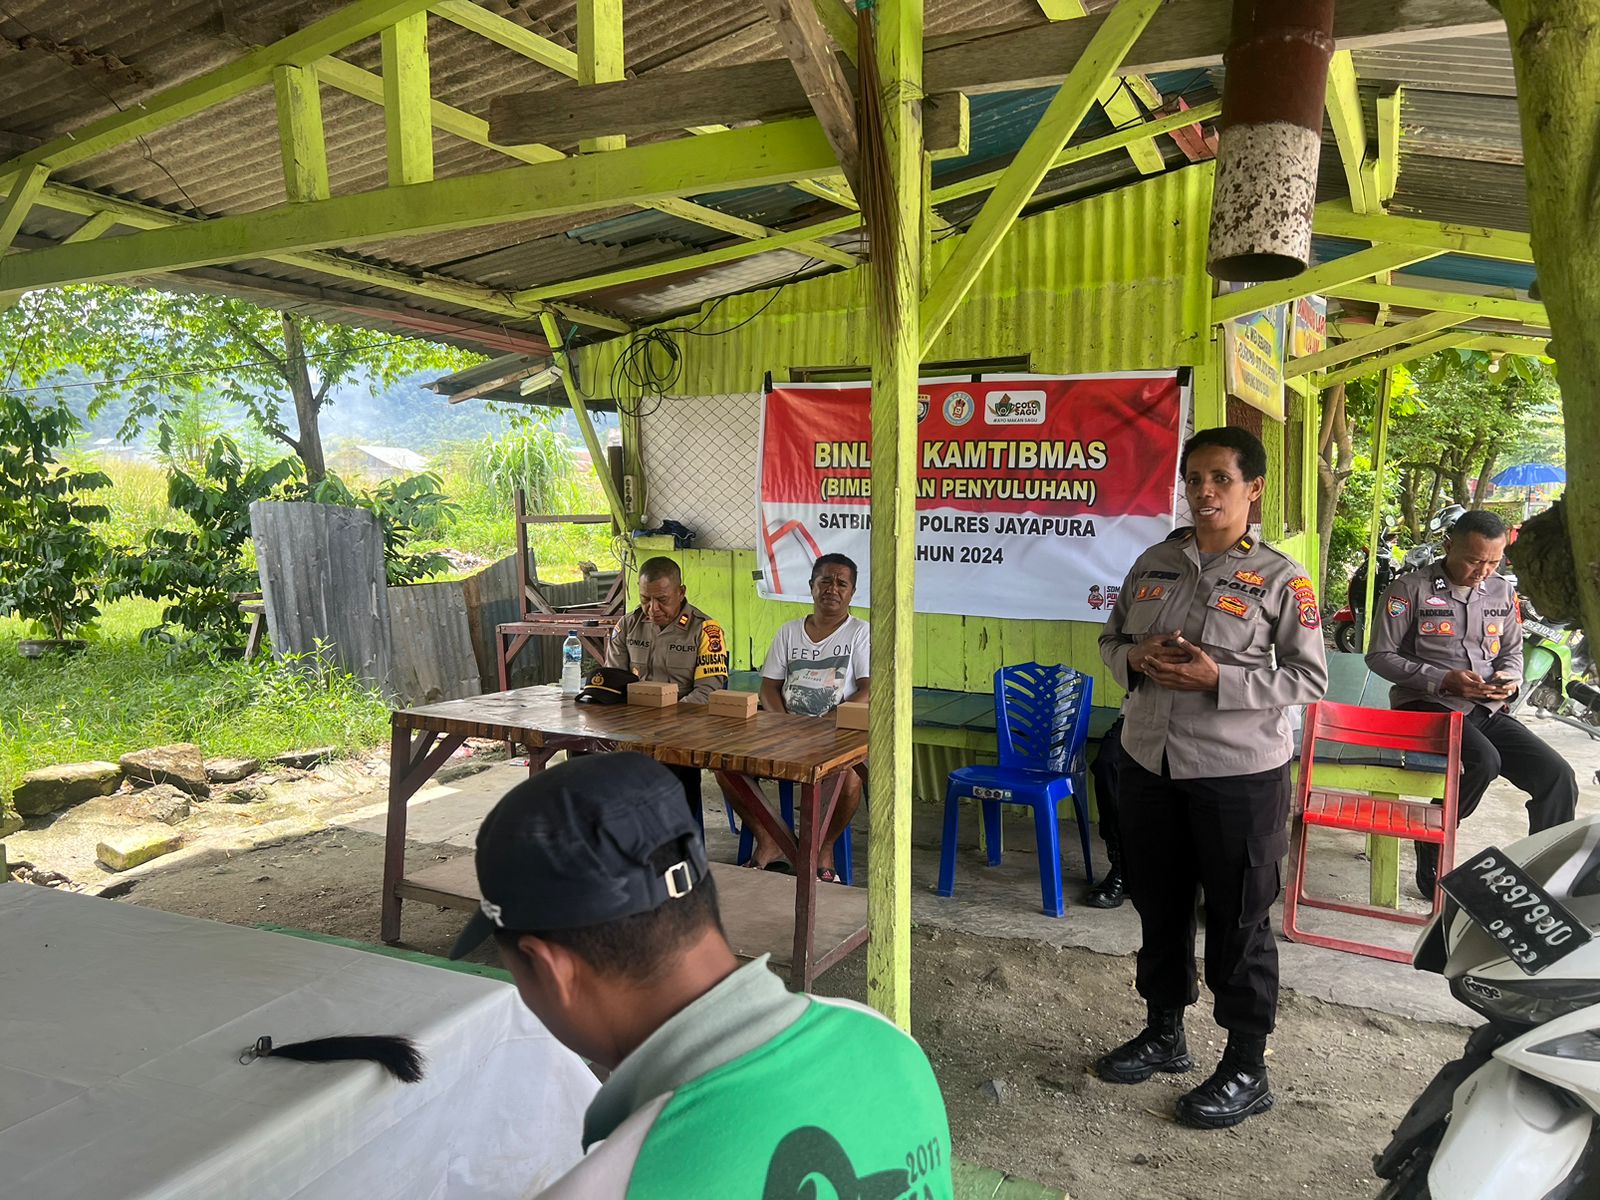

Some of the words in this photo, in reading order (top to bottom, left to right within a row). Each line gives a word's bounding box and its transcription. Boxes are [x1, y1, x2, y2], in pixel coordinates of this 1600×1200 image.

[814, 441, 871, 470] BINL
[922, 440, 1108, 470] KAMTIBMAS
[941, 478, 1097, 506] PENYULUHAN)
[919, 515, 989, 534] POLRES
[994, 517, 1097, 538] JAYAPURA
[959, 546, 1004, 564] 2024
[1216, 578, 1267, 598] POLRI
[669, 644, 697, 652] POLRI
[833, 643, 851, 656] ON
[905, 1136, 941, 1183] 2017
